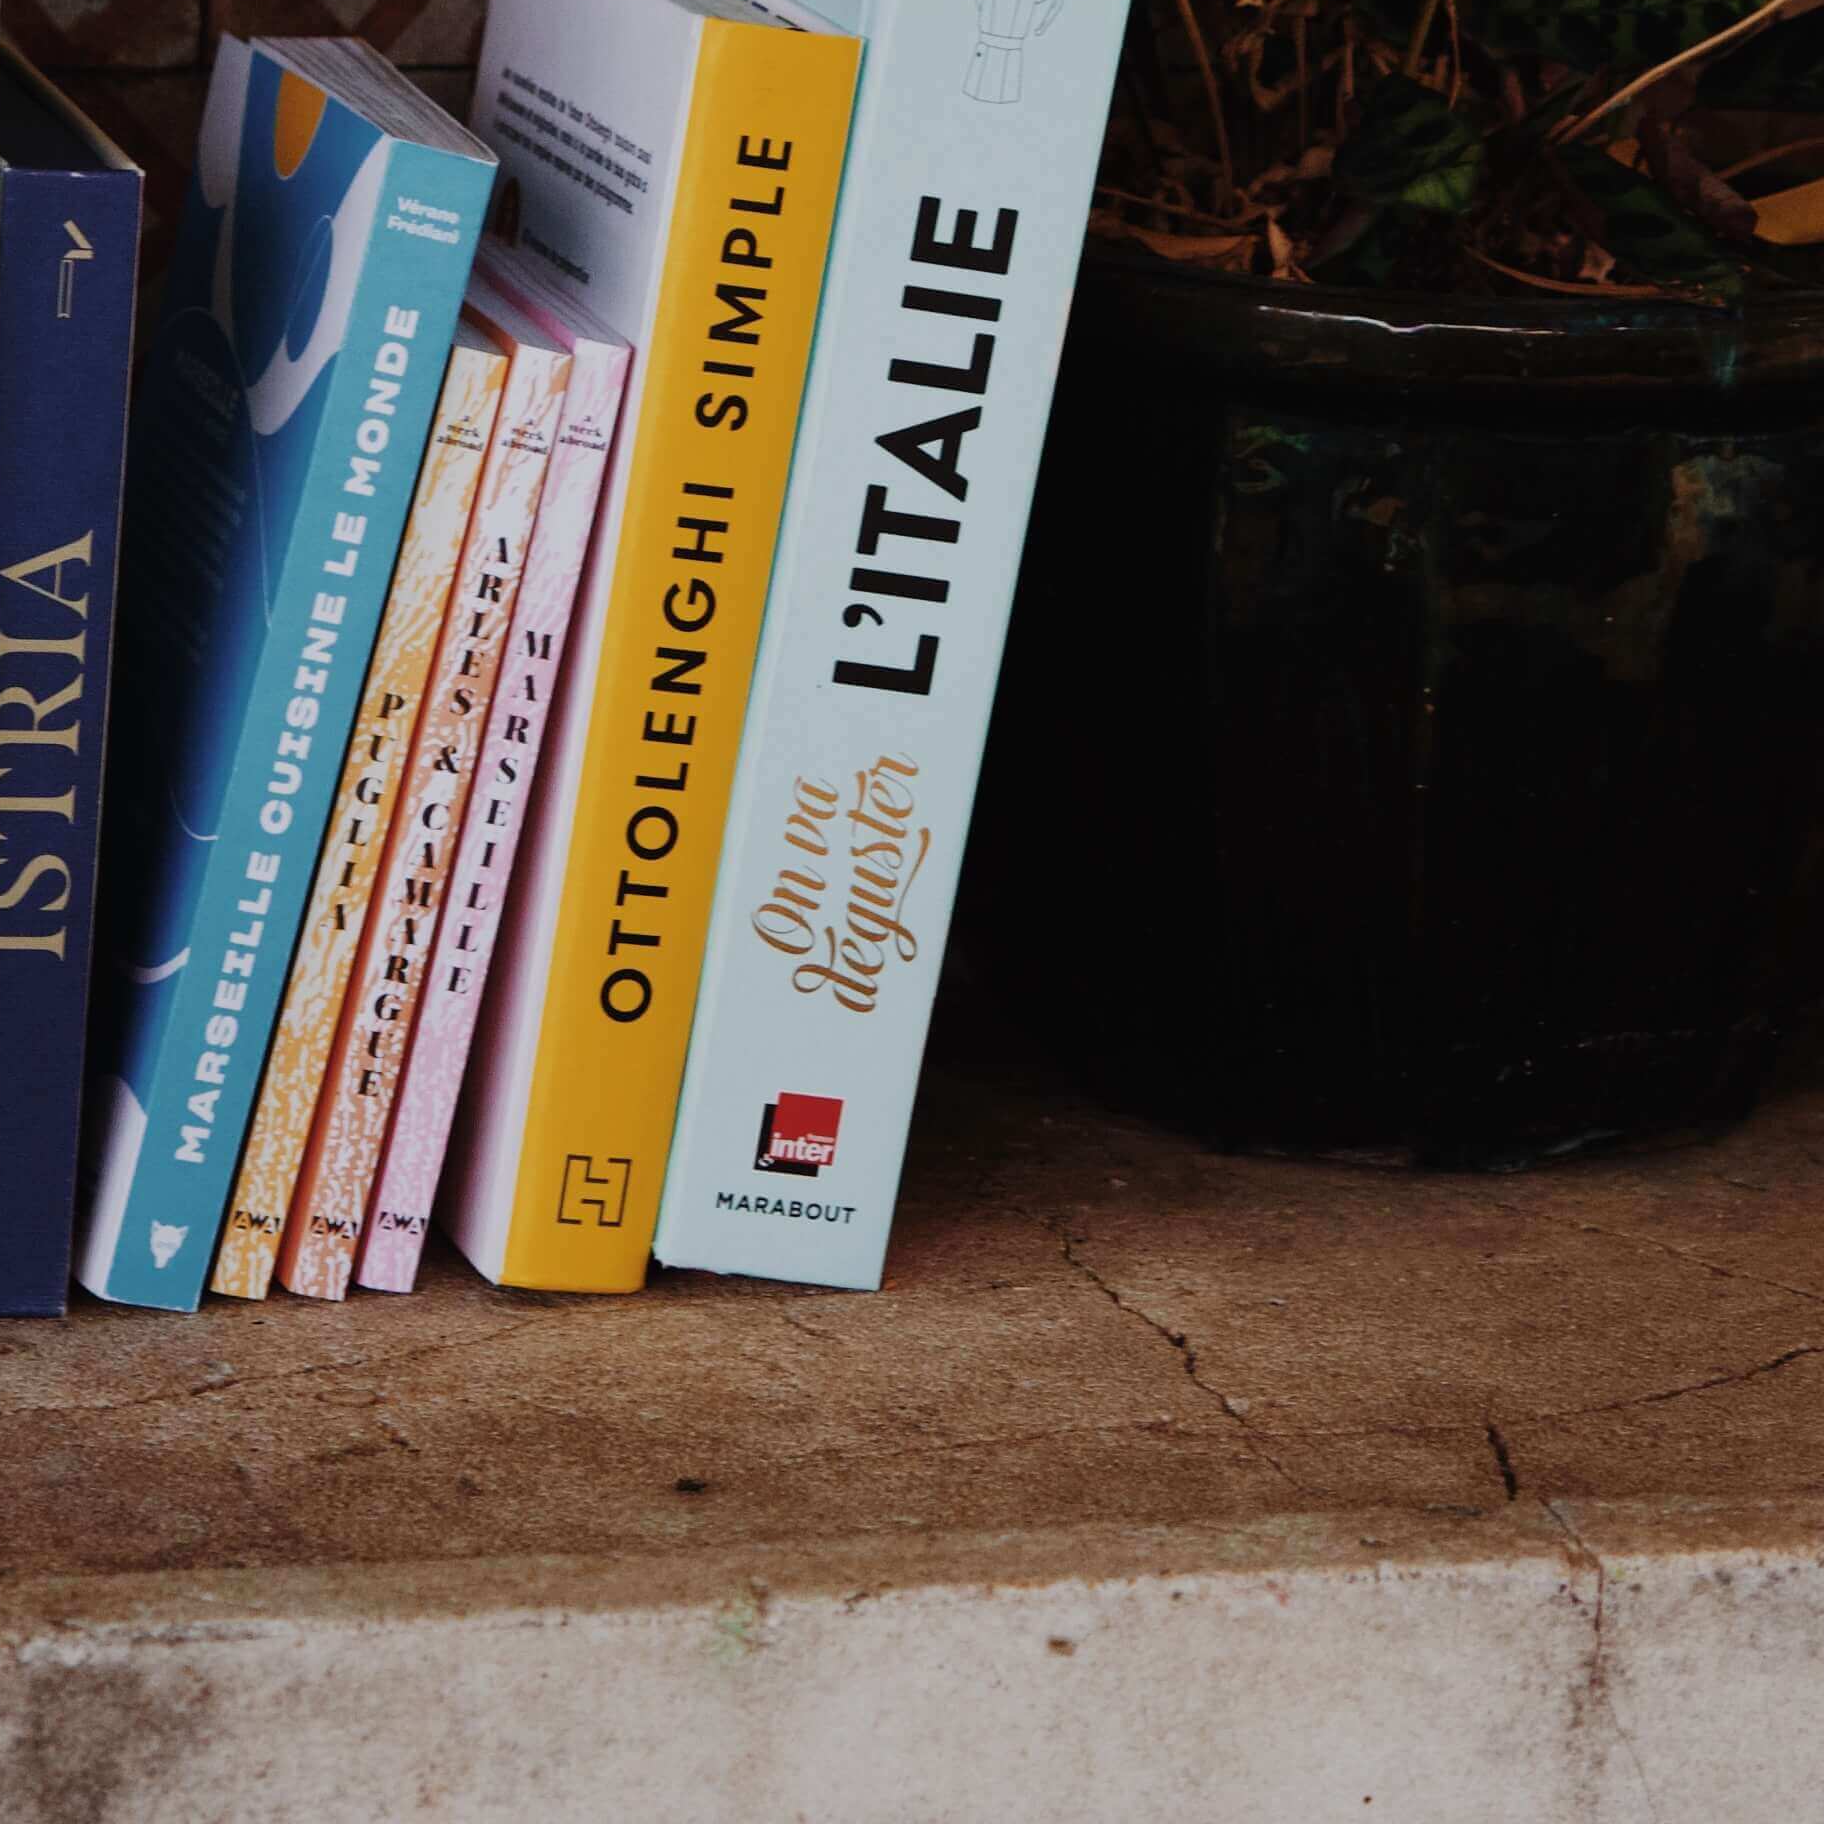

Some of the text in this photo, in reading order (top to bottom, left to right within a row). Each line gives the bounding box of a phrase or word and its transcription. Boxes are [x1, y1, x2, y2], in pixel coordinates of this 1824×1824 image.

[398, 196, 459, 224] Vérane
[437, 436, 483, 451] abroad
[502, 438, 549, 455] abroad
[560, 436, 607, 451] abroad
[832, 196, 1019, 695] L'ITALIE
[600, 135, 792, 1023] OTTOLENGHI SIMPLE
[175, 306, 420, 1164] MARSEILLE CUISINE LE MONDE
[324, 692, 405, 932] PUGLIA
[358, 536, 509, 1098] ARLES & CAMARGUE
[447, 629, 555, 996] MARSEILLE
[752, 776, 839, 955] On va
[716, 1192, 857, 1224] MARABOUT
[769, 1132, 834, 1163] inter
